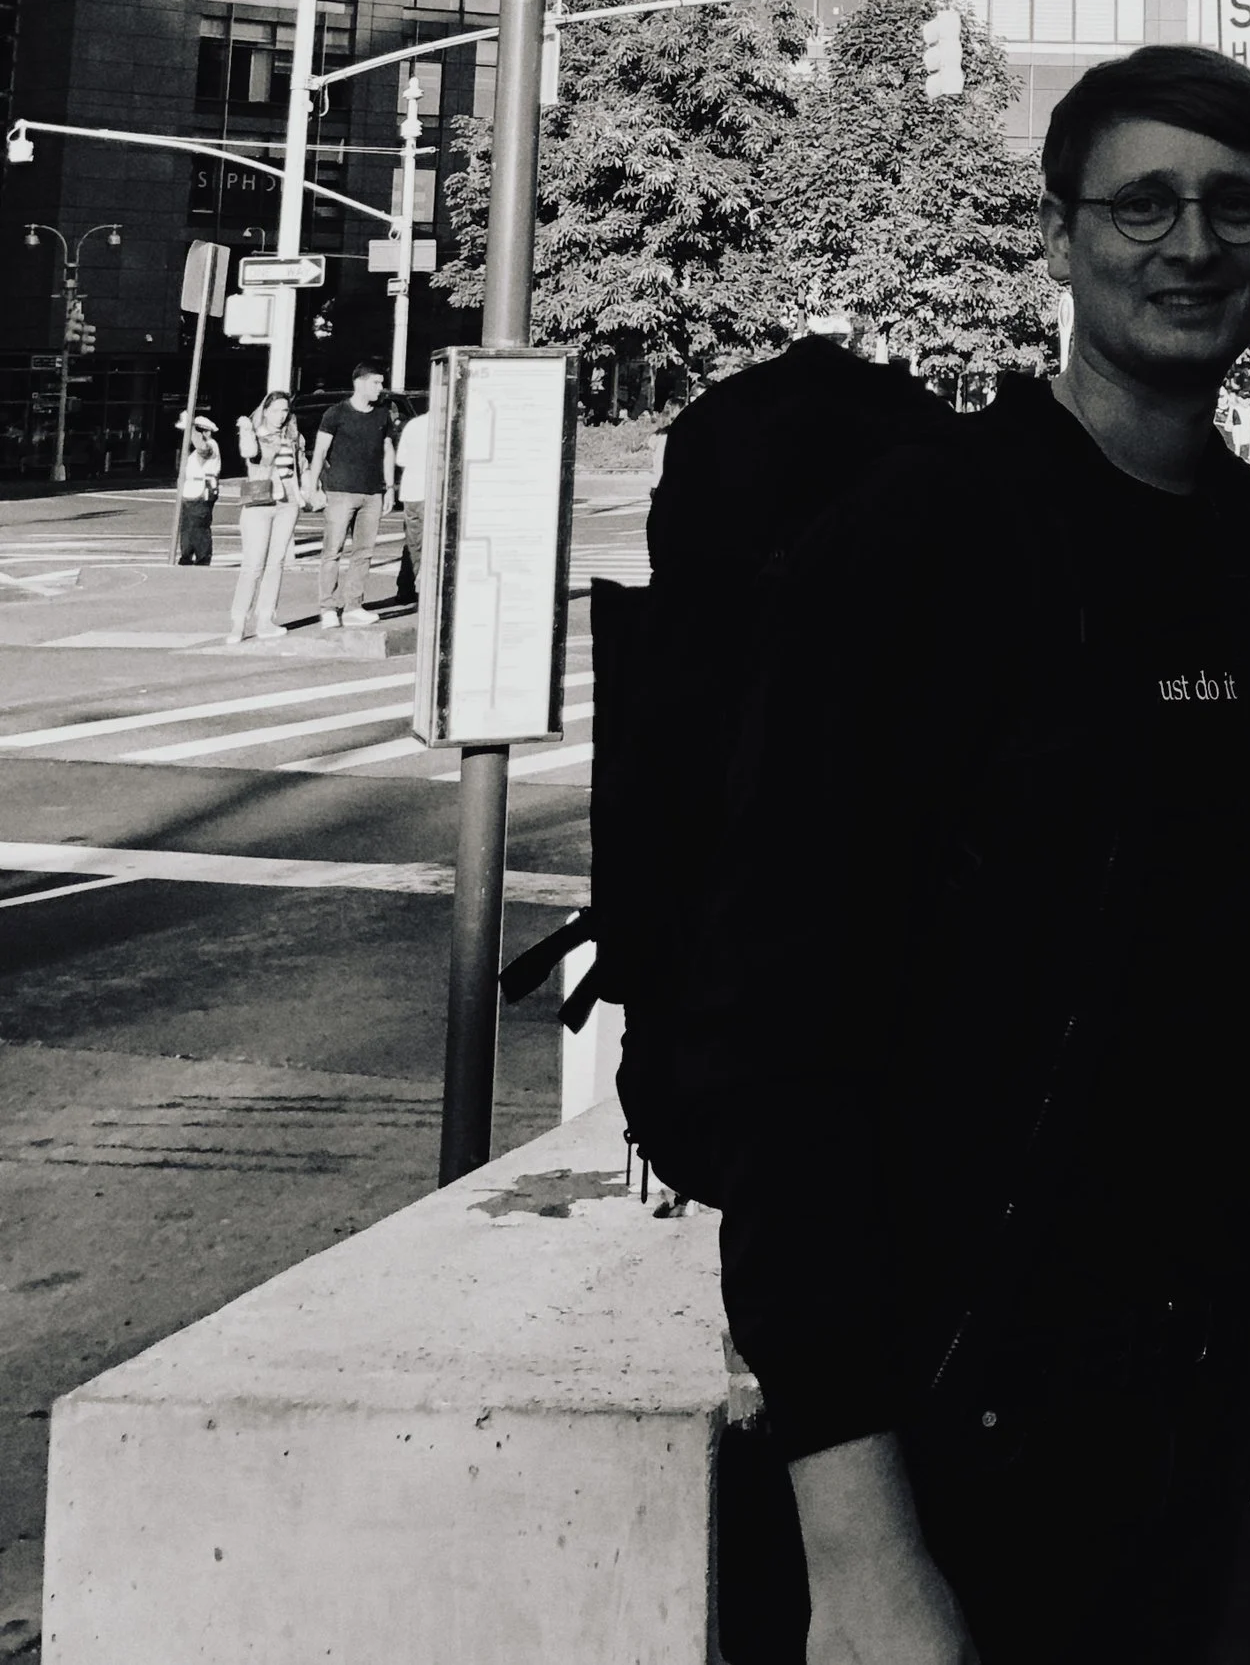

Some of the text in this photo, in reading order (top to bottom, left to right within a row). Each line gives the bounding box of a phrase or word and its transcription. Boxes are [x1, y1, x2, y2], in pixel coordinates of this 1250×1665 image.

[1158, 670, 1238, 700] ust do it
